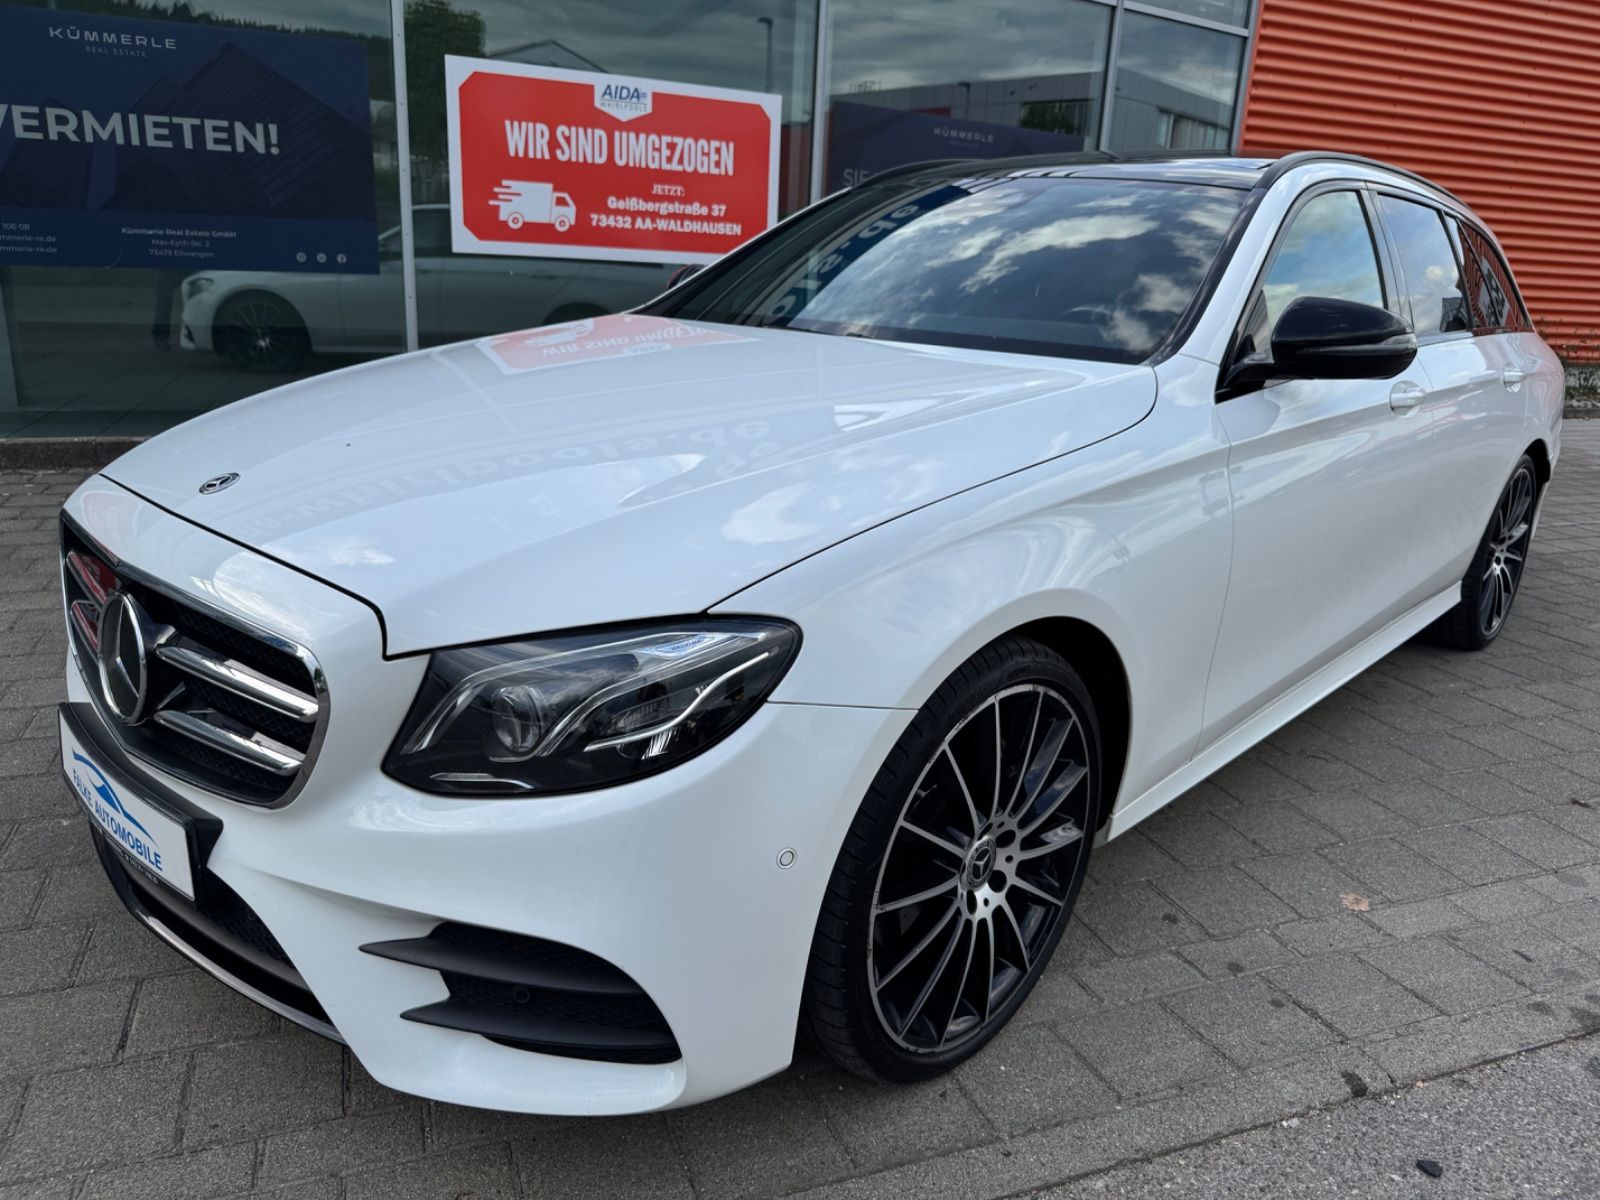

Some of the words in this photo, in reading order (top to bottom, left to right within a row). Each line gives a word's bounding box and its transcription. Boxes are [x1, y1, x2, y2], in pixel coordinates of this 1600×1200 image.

[49, 26, 177, 50] KÜMMERLE
[602, 84, 641, 102] AIDA
[933, 126, 995, 143] KÜMMERLE
[504, 119, 550, 160] WIR
[556, 125, 608, 166] SIND
[614, 131, 735, 176] UMGEZOGEN
[651, 183, 686, 197] JETZT:
[607, 196, 709, 217] Geißbergstraße
[711, 204, 727, 217] 37
[121, 227, 164, 236] Kümmerle
[166, 228, 183, 236] Real
[185, 229, 210, 237] Estate
[211, 230, 237, 238] GmbH
[590, 213, 632, 229] 73432
[635, 217, 742, 236] AA-WALDHAUSEN
[73, 769, 92, 806] FALKE
[95, 800, 163, 872] AUTOMOBILE
